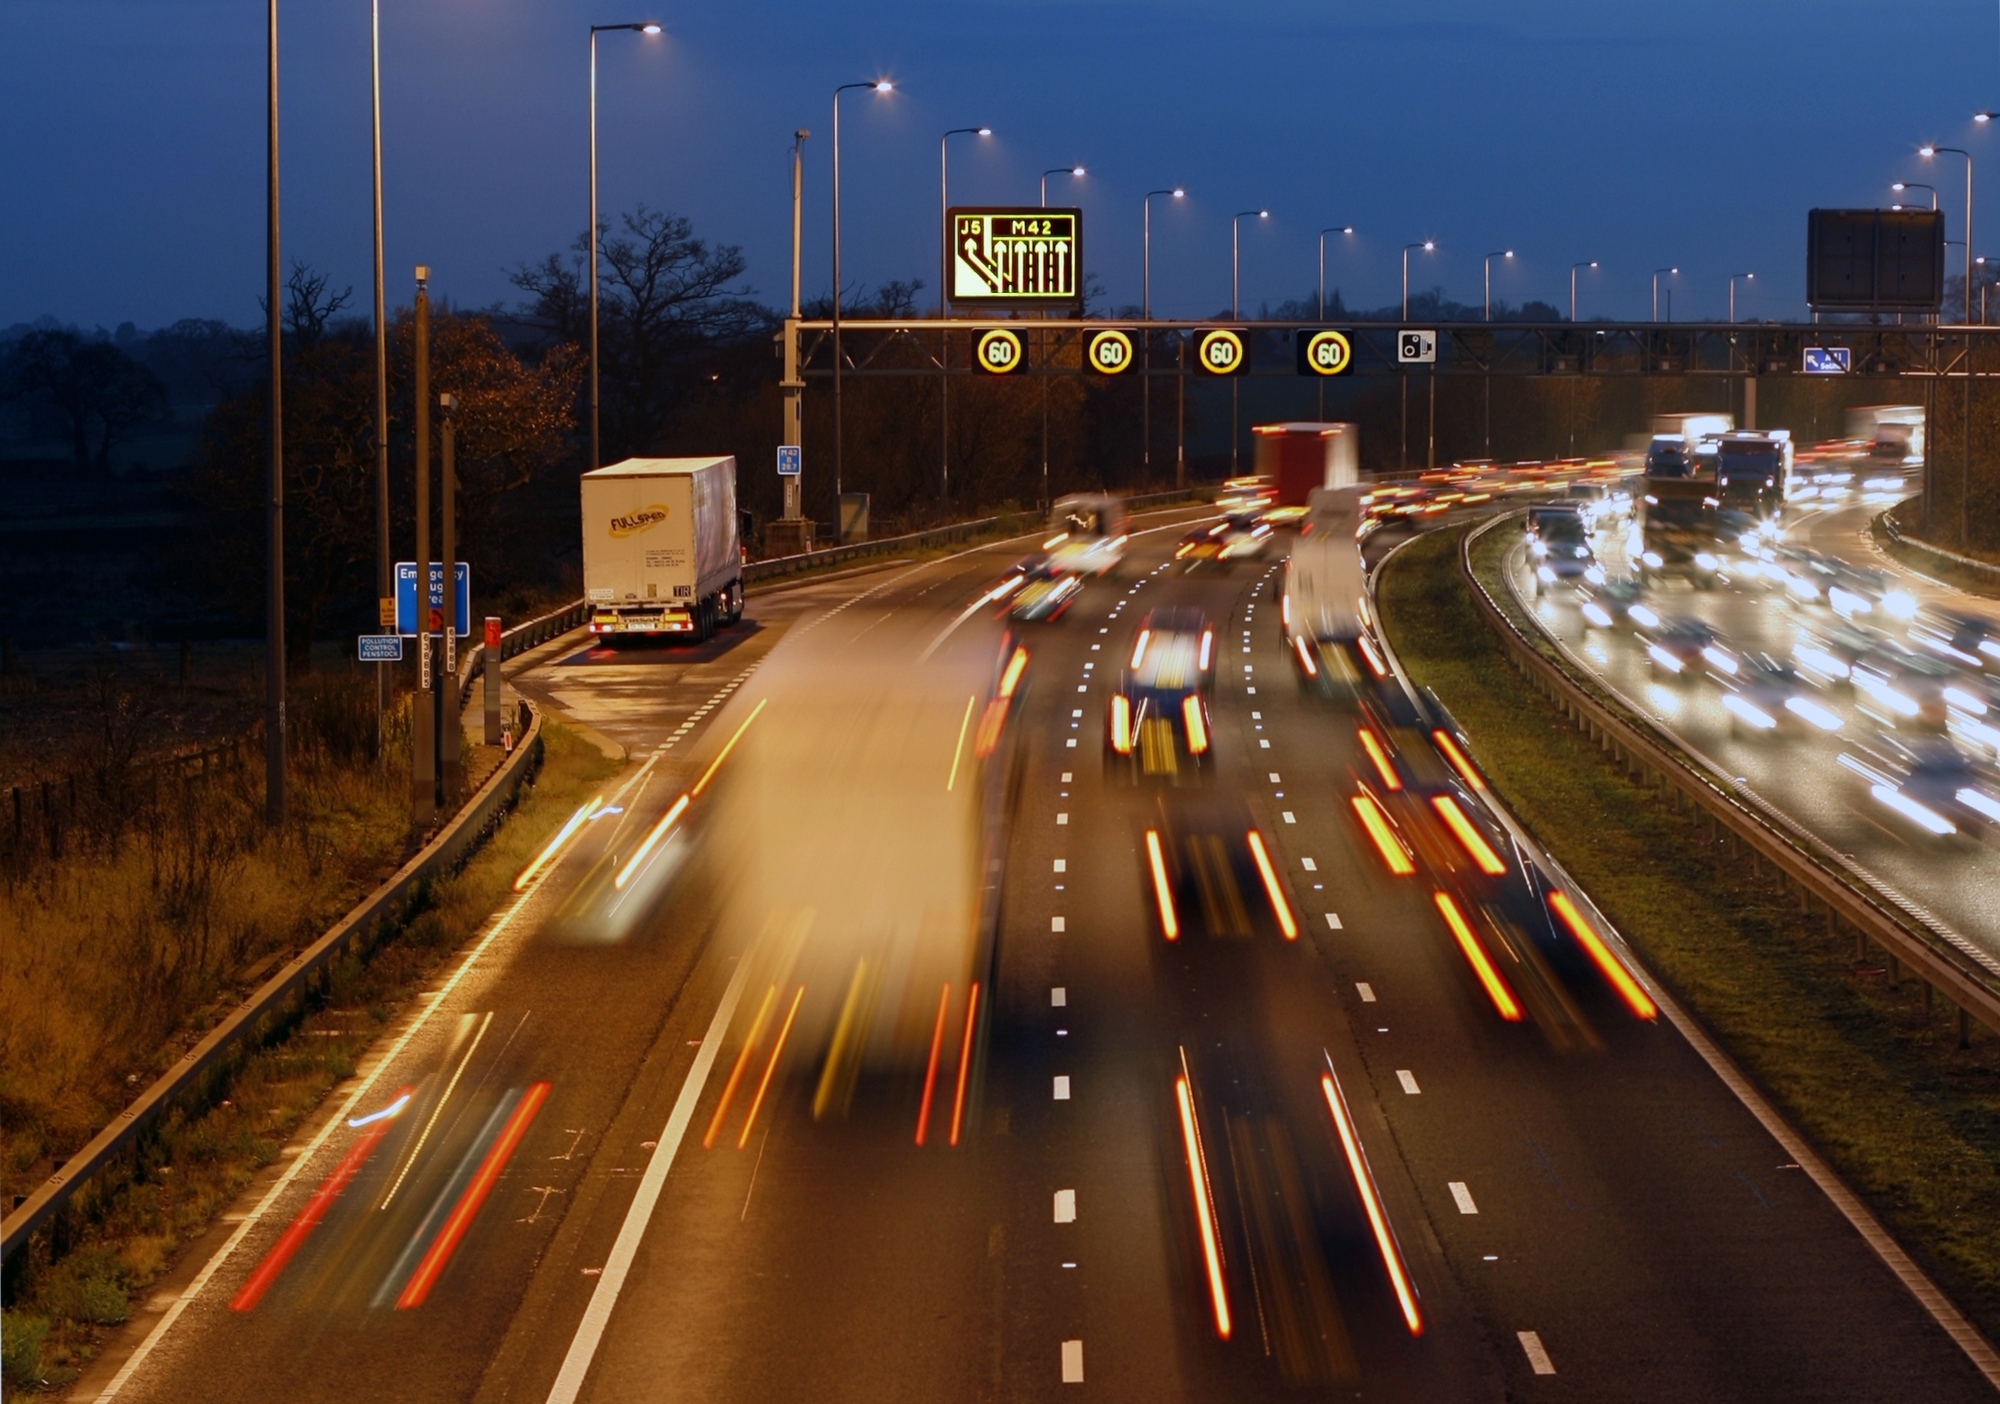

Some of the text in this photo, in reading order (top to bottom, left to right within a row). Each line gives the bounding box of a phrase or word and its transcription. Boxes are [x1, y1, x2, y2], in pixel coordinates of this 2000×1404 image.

[961, 220, 981, 235] J5
[1012, 220, 1052, 235] M42
[988, 341, 1012, 364] 60
[1100, 342, 1123, 365] 60
[1210, 342, 1233, 365] 60
[1317, 342, 1341, 366] 60
[400, 568, 464, 581] Emgey
[674, 586, 690, 597] TIR
